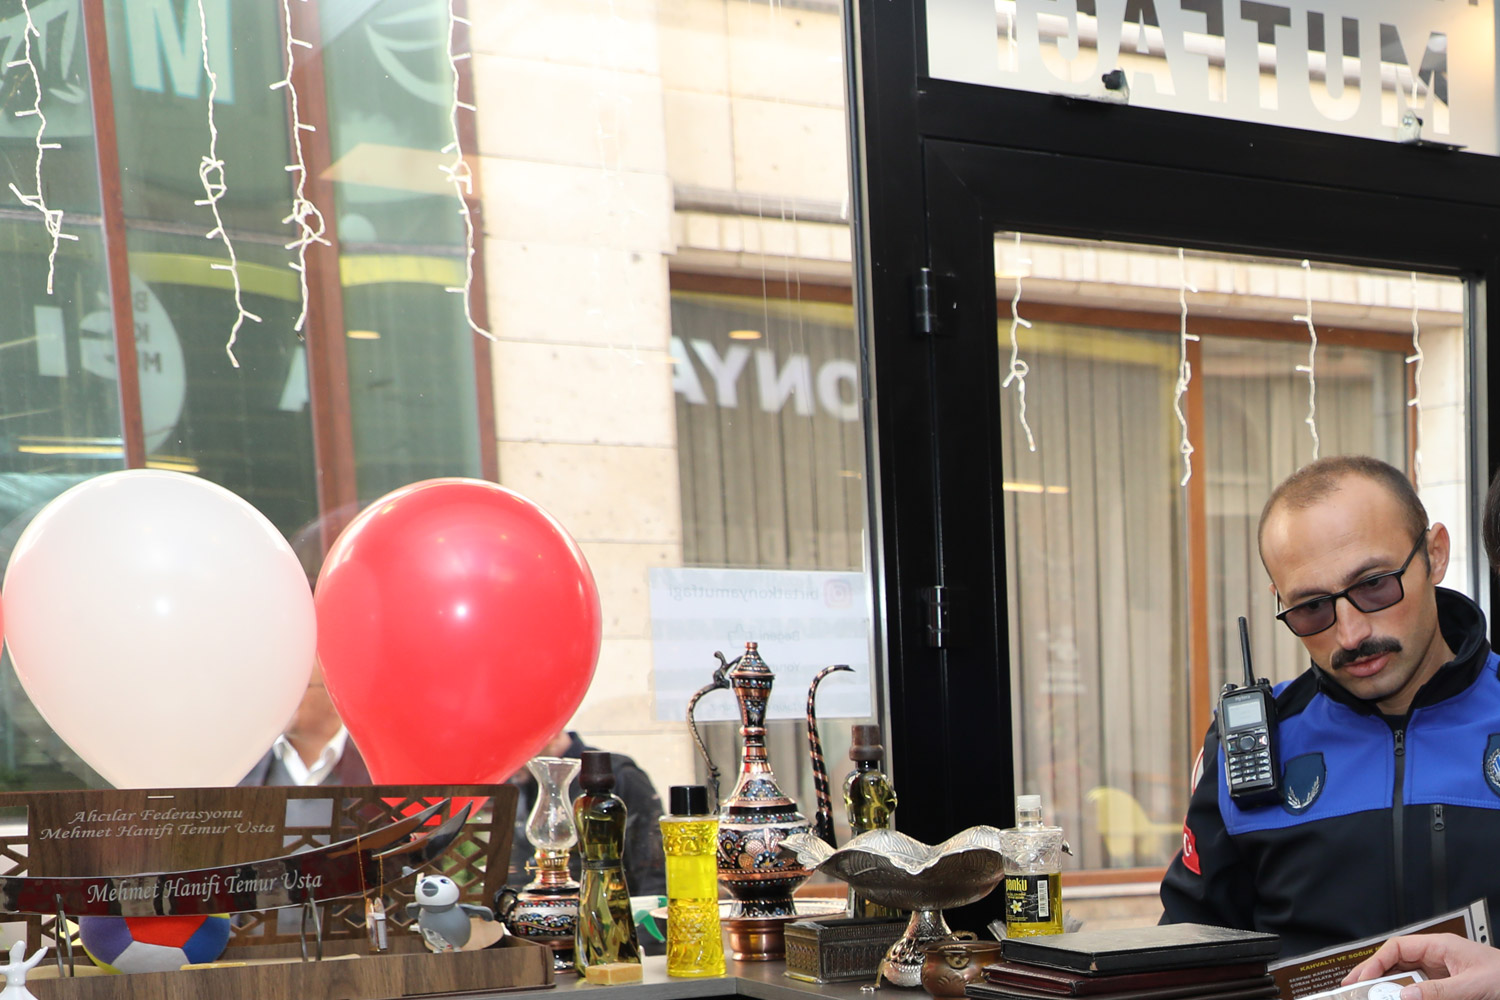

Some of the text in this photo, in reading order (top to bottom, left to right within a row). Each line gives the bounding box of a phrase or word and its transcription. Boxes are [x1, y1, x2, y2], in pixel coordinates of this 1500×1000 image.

[140, 807, 243, 822] Federasyonu
[40, 821, 276, 840] Mehmet Hanifi Temur Usta
[87, 868, 323, 904] Mehmet Hanifi Temur Usta
[1300, 958, 1335, 972] KAHVALTI
[1349, 948, 1374, 960] SOĞUK
[1311, 974, 1332, 983] SALATA
[1313, 966, 1340, 977] KAHVALTI
[1313, 980, 1334, 989] SALATA
